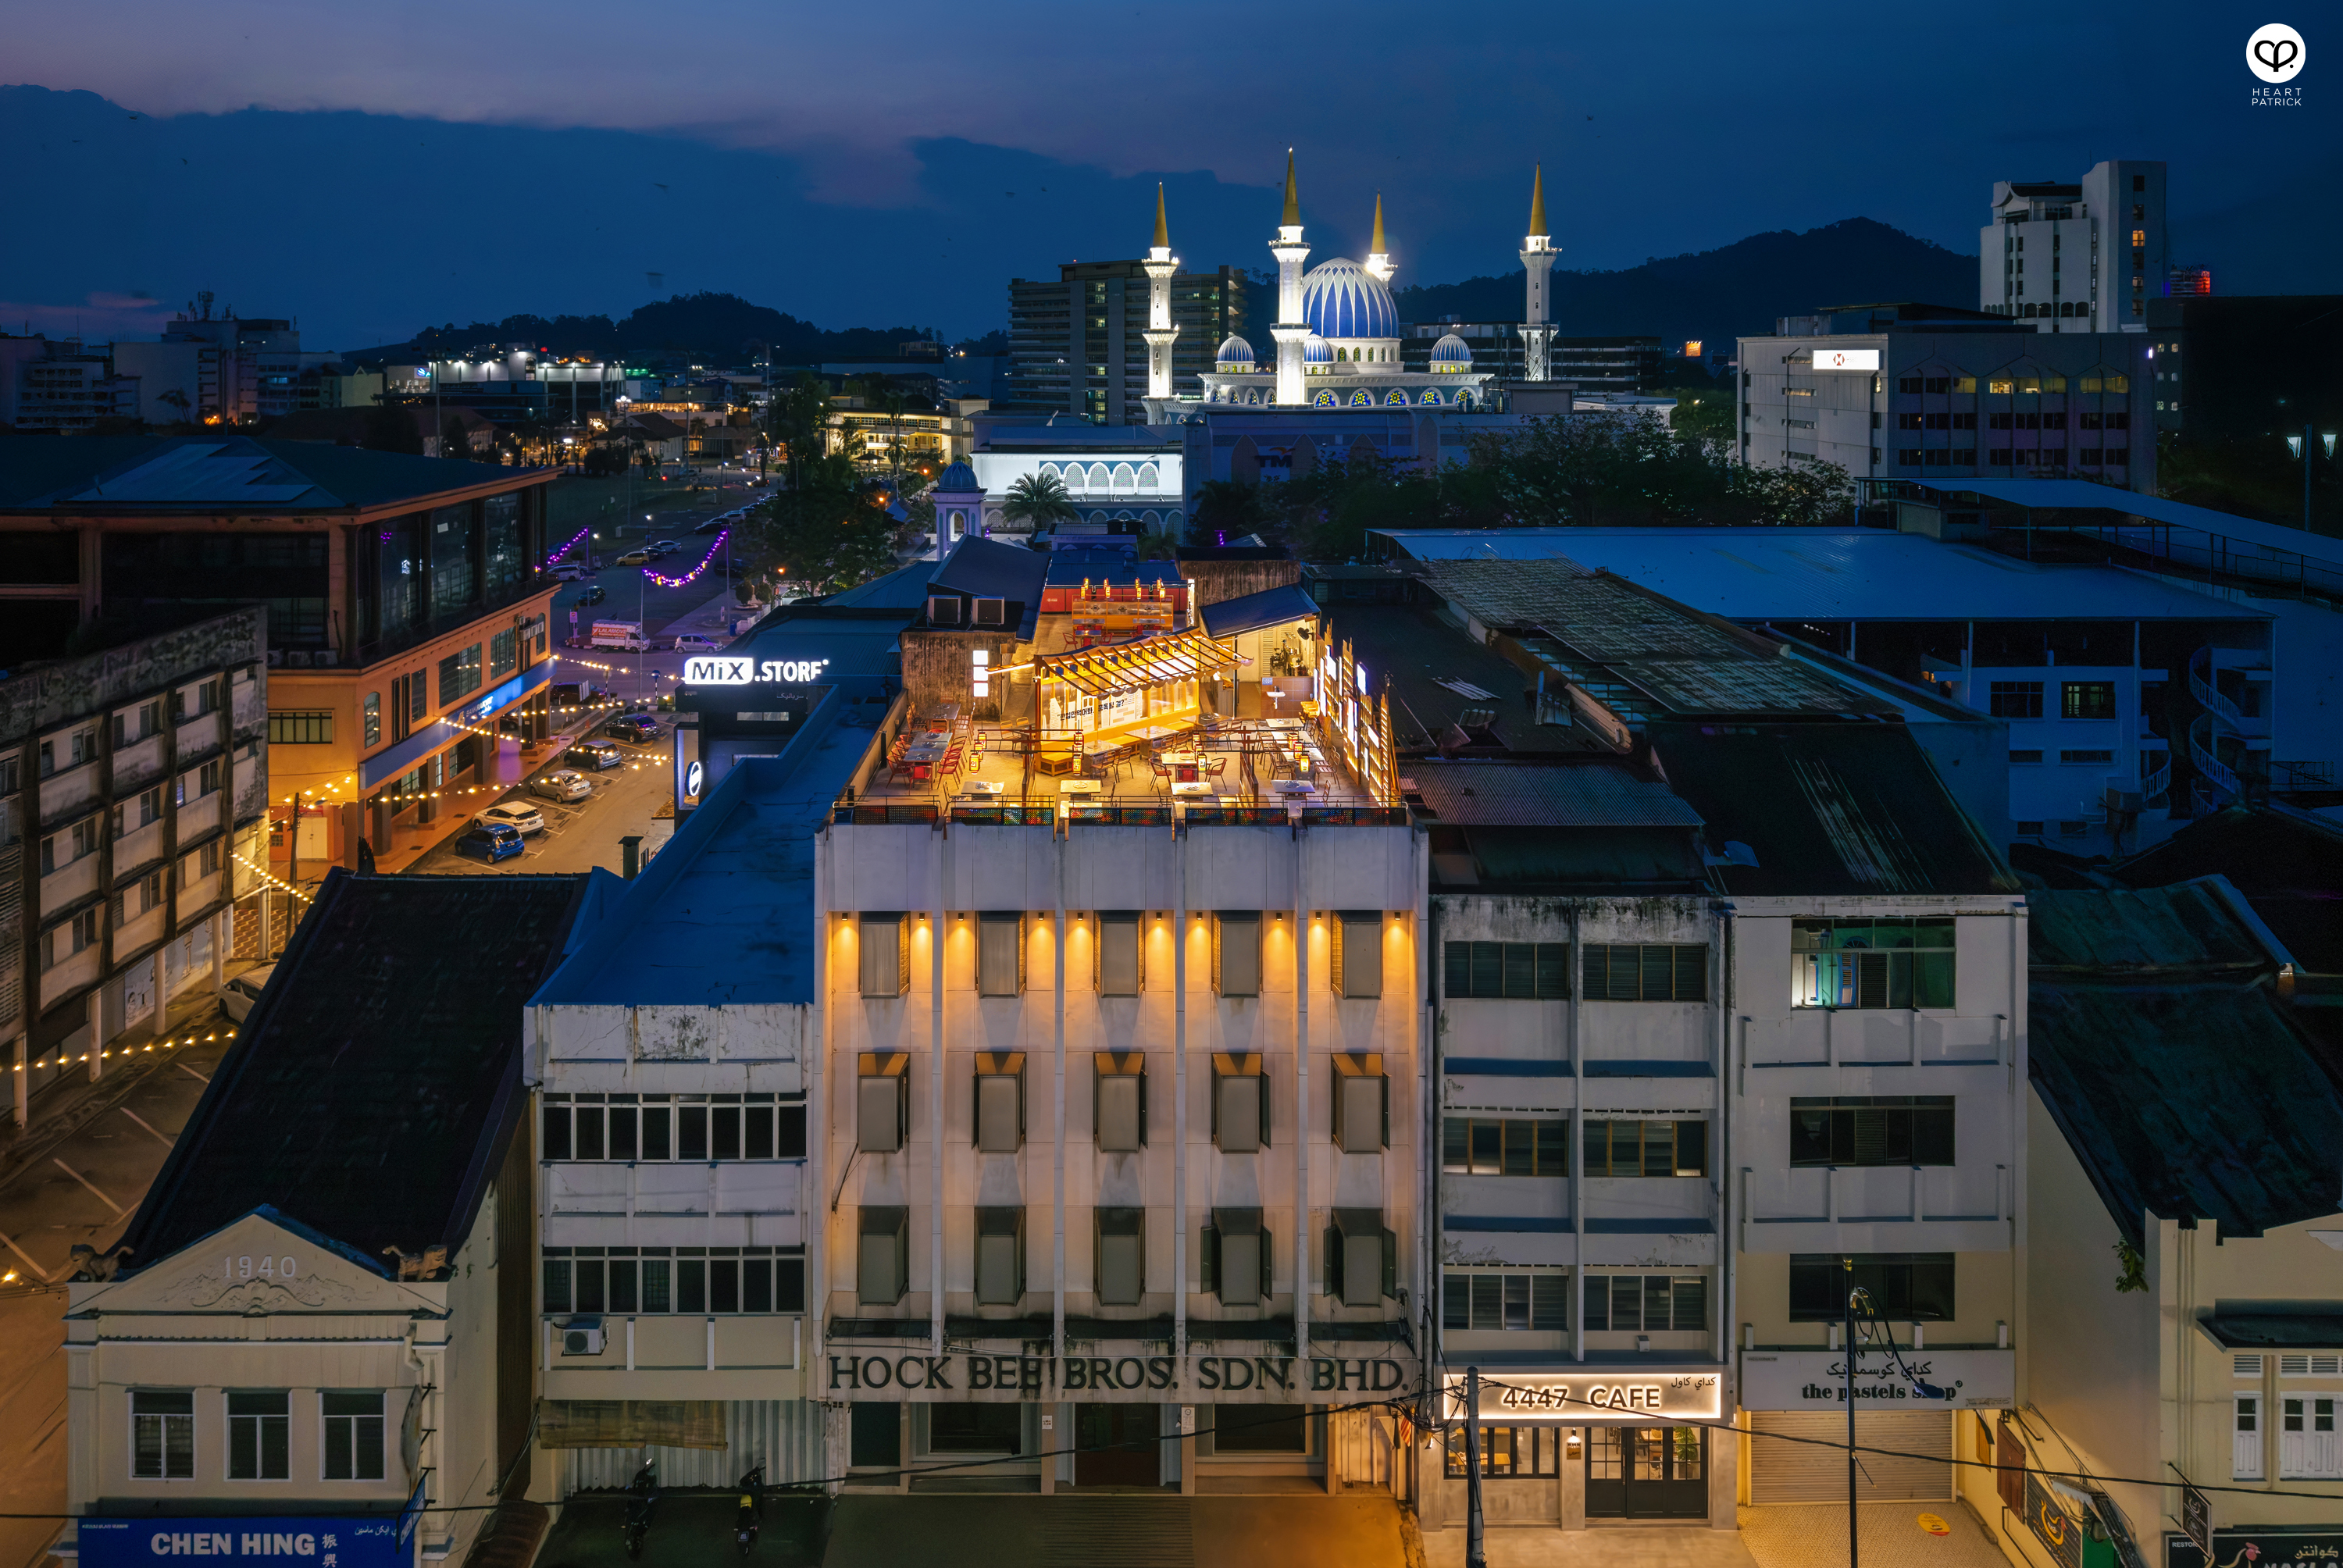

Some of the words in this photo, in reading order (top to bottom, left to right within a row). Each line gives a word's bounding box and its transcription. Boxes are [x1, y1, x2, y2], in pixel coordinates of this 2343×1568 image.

[1254, 455, 1293, 469] TM
[223, 1256, 296, 1278] 1940
[829, 1356, 954, 1389] HOCK
[968, 1356, 1043, 1390] BEE
[1062, 1357, 1179, 1390] BROS.
[1198, 1357, 1296, 1391] SDN.
[1309, 1358, 1409, 1392] BHD.
[1503, 1388, 1568, 1409] 4447
[1589, 1388, 1660, 1409] CAFE
[1802, 1383, 1833, 1399] the
[1837, 1383, 1906, 1402] pastels
[1911, 1384, 1957, 1402] sp
[151, 1533, 232, 1556] CHEN
[241, 1533, 316, 1556] HING
